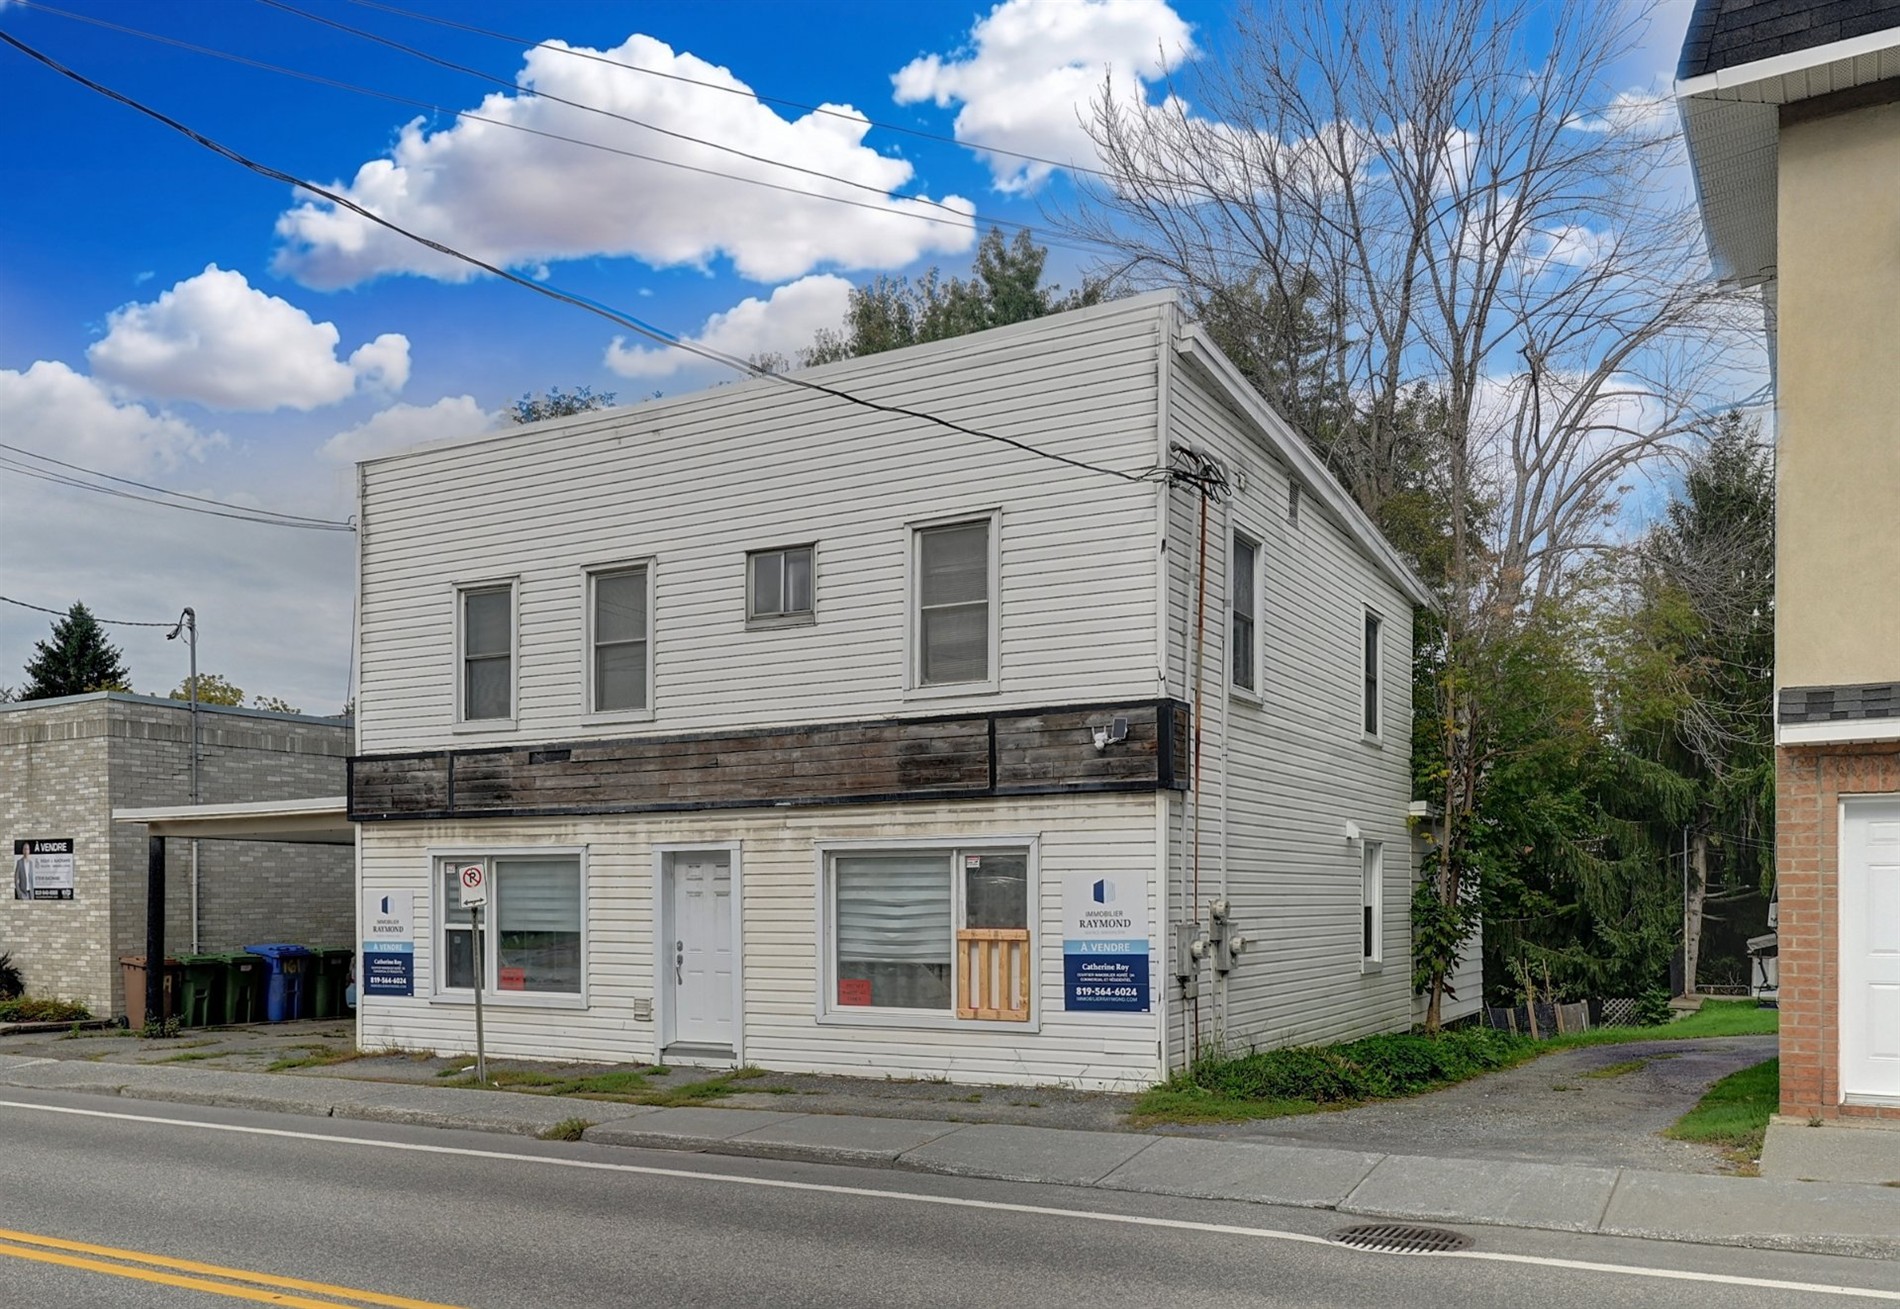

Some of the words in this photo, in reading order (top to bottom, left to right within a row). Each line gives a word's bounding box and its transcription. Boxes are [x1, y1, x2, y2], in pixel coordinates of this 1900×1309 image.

[40, 842, 68, 852] VENDRE
[1079, 919, 1131, 928] RAYMOND
[380, 943, 403, 951] VENDRE
[1091, 943, 1131, 952] VENDRE
[1081, 963, 1115, 971] Catherine
[1116, 963, 1130, 972] Roy
[370, 976, 407, 984] 819-564-6024
[1076, 987, 1137, 996] 819-564-6024
